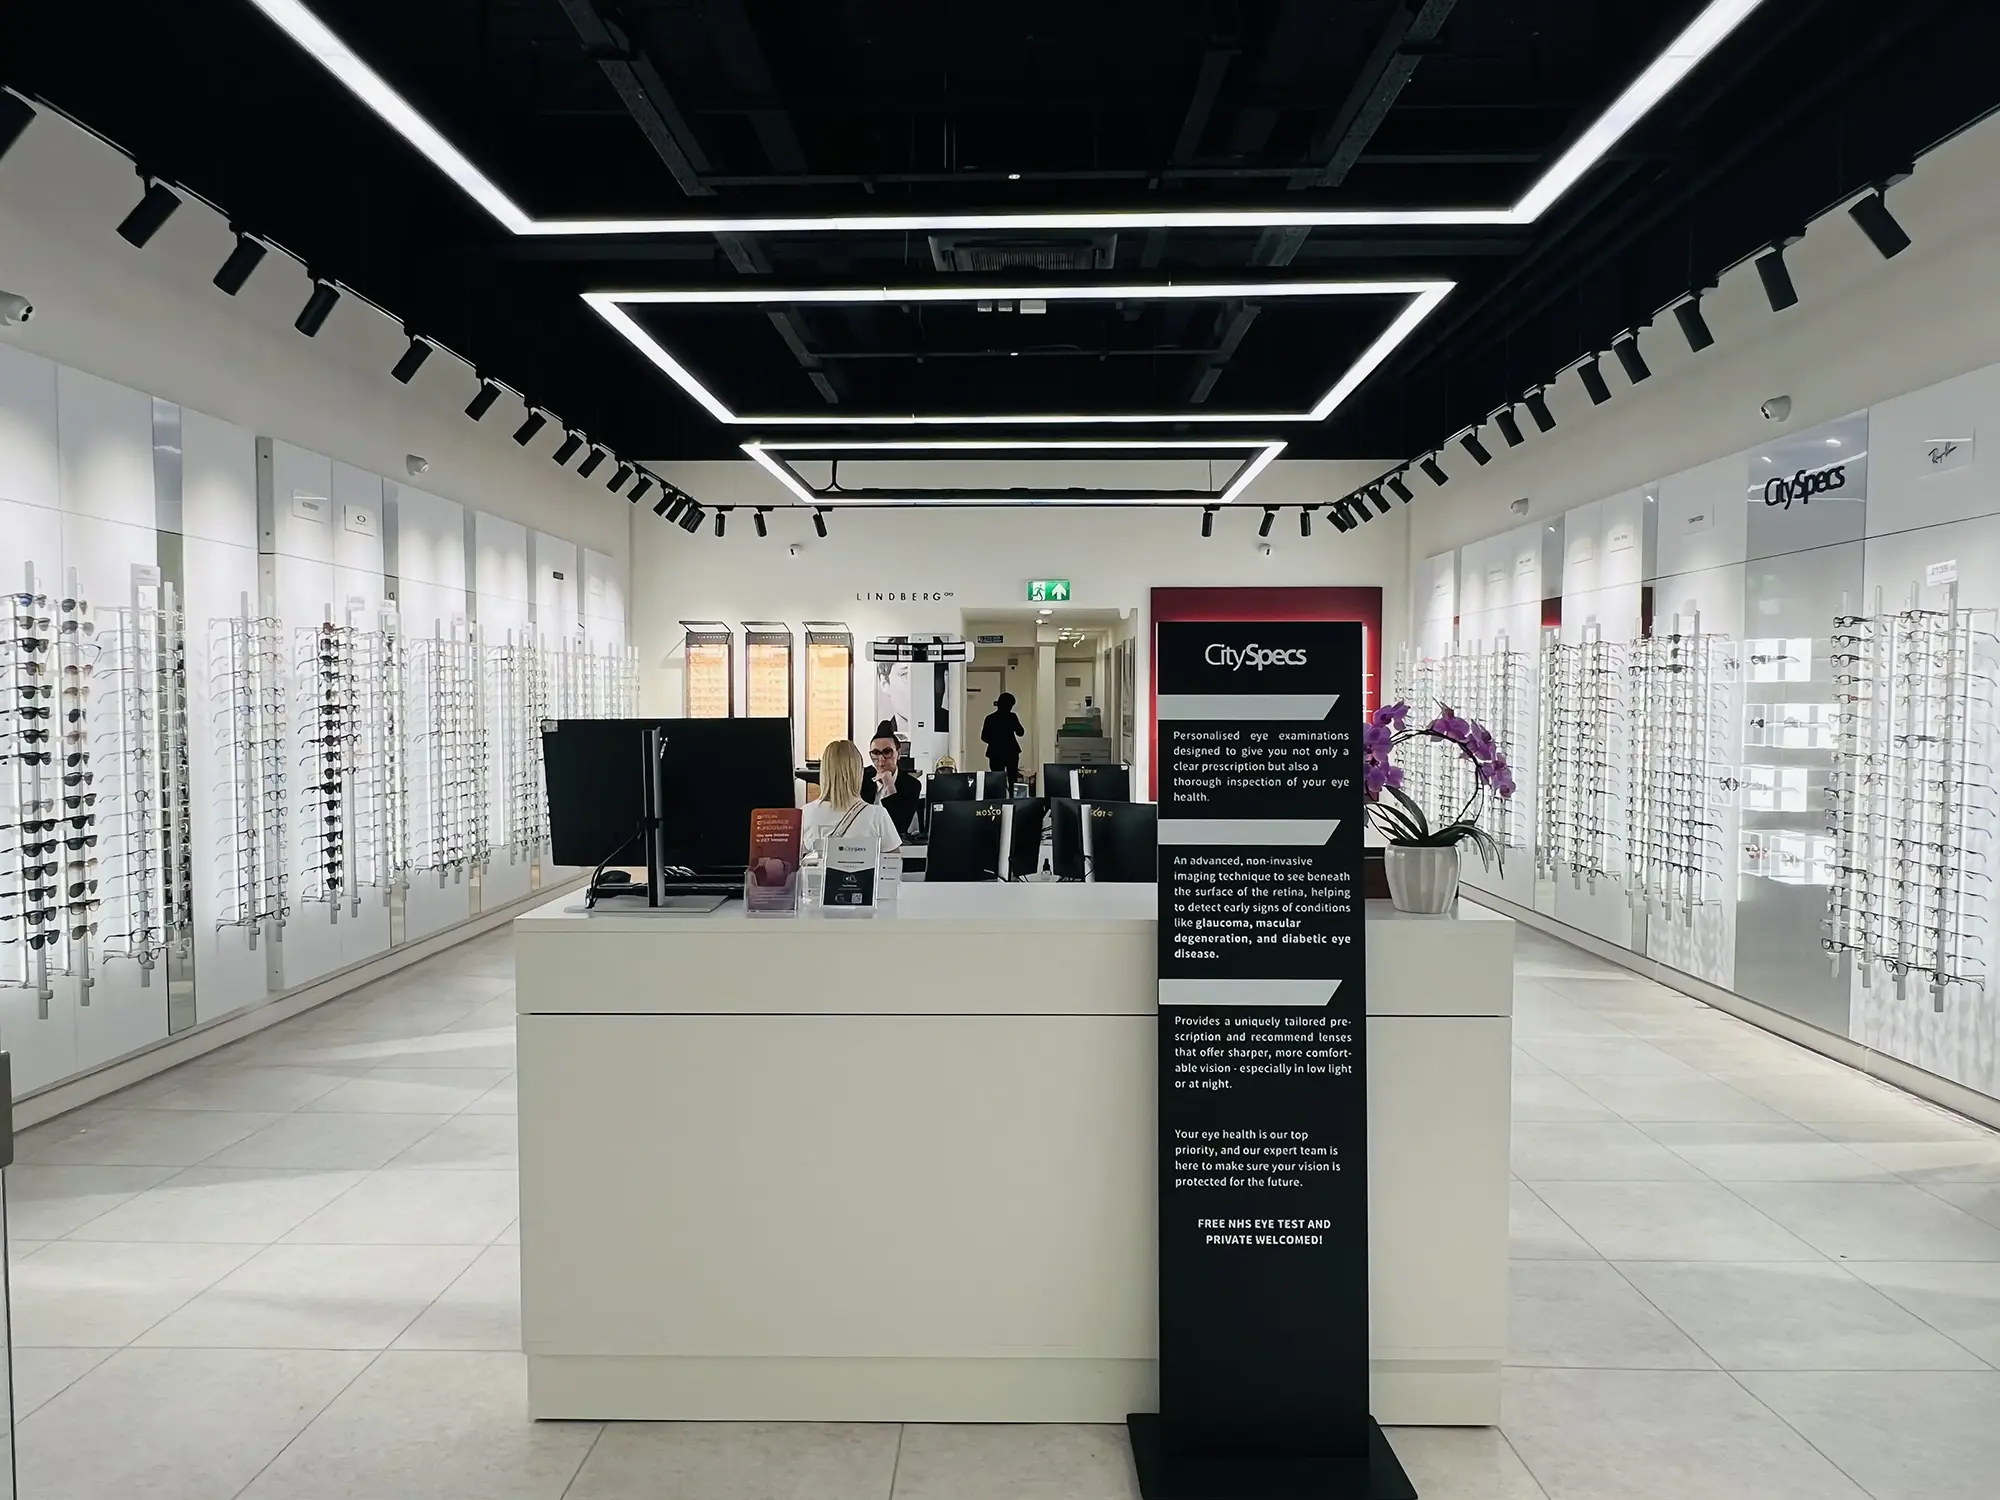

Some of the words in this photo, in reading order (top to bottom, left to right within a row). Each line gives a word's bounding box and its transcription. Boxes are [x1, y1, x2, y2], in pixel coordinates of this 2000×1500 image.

[1764, 465, 1846, 510] CitySpecs
[856, 592, 942, 602] LINDBERG
[1205, 643, 1307, 671] CitySpecs
[1173, 731, 1240, 740] Personalised
[1250, 733, 1268, 742] eye
[1278, 731, 1349, 740] examinations
[1173, 746, 1220, 758] designed
[1226, 747, 1236, 756] to
[1241, 746, 1263, 758] give
[1268, 748, 1287, 758] you
[1292, 748, 1310, 756] not
[1315, 746, 1338, 758] only
[1343, 748, 1349, 756] a
[1173, 761, 1199, 771] clear
[1202, 762, 1265, 773] prescription
[1268, 761, 1285, 771] but
[1288, 762, 1310, 771] also
[1174, 777, 1221, 788] thorough
[1227, 777, 1281, 788] inspection
[1287, 777, 1298, 787] of
[1302, 779, 1326, 788] your
[1331, 779, 1349, 789] eye
[1174, 792, 1210, 802] health.
[1174, 856, 1187, 865] An
[1190, 856, 1244, 866] advanced,
[1246, 856, 1313, 866] non-invasive
[1174, 871, 1216, 883] imaging
[1218, 871, 1271, 883] technique
[1274, 872, 1284, 881] to
[1287, 873, 1305, 881] see
[1307, 872, 1350, 881] beneath
[1174, 886, 1191, 896] the
[1195, 886, 1233, 896] surface
[1237, 886, 1248, 896] of
[1251, 887, 1269, 897] the
[1273, 887, 1307, 898] retina,
[1311, 887, 1351, 899] helping
[1174, 903, 1185, 912] to
[1188, 902, 1221, 912] detect
[1223, 902, 1250, 914] early
[1253, 903, 1279, 914] signs
[1282, 902, 1293, 912] of
[1295, 903, 1351, 912] conditions
[1174, 918, 1193, 927] like
[1195, 918, 1253, 930] glaucoma,
[1256, 918, 1301, 928] macular
[1174, 933, 1252, 945] degeneration,
[1256, 933, 1277, 943] and
[1282, 933, 1327, 944] diabetic
[1331, 936, 1351, 946] eye
[1174, 948, 1219, 959] disease.
[1175, 1016, 1220, 1026] Provides
[1224, 1018, 1230, 1026] a
[1235, 1016, 1280, 1028] uniquely
[1285, 1016, 1326, 1026] tailored
[1330, 1019, 1351, 1028] pre-
[1175, 1032, 1221, 1043] scription
[1226, 1032, 1246, 1041] and
[1251, 1032, 1314, 1042] recommend
[1319, 1032, 1352, 1042] lenses
[1175, 1047, 1196, 1057] that
[1200, 1047, 1224, 1057] offer
[1228, 1048, 1272, 1059] sharper,
[1275, 1050, 1303, 1058] more
[1306, 1047, 1352, 1058] comfort-
[1175, 1063, 1197, 1073] able
[1200, 1063, 1231, 1073] vision
[1239, 1063, 1292, 1075] especially
[1294, 1063, 1304, 1073] in
[1307, 1064, 1326, 1073] low
[1328, 1064, 1352, 1076] light
[1189, 1080, 1199, 1088] at
[1202, 1079, 1232, 1091] night.
[1175, 1129, 1199, 1139] Your
[1201, 1131, 1220, 1141] eye
[1223, 1129, 1256, 1139] health
[1259, 1129, 1267, 1139] is
[1291, 1131, 1309, 1141] top
[1175, 1145, 1218, 1157] priority,
[1220, 1145, 1240, 1155] and
[1243, 1147, 1261, 1155] our
[1263, 1147, 1297, 1157] expert
[1300, 1146, 1327, 1155] team
[1330, 1146, 1338, 1155] is
[1175, 1160, 1199, 1171] here
[1202, 1162, 1213, 1171] to
[1215, 1161, 1244, 1171] make
[1246, 1163, 1269, 1171] sure
[1272, 1163, 1296, 1173] your
[1298, 1161, 1329, 1171] vision
[1332, 1161, 1341, 1171] is
[1175, 1177, 1227, 1188] protected
[1230, 1176, 1245, 1187] for
[1247, 1177, 1265, 1187] the
[1267, 1176, 1303, 1187] future.
[1198, 1219, 1225, 1228] FREE
[1228, 1219, 1252, 1229] NHS
[1255, 1219, 1274, 1229] EYE
[1277, 1219, 1305, 1229] TEST
[1307, 1219, 1331, 1229] AND
[1206, 1235, 1252, 1245] PRIVATE
[1255, 1235, 1322, 1245] WELCOMED!
